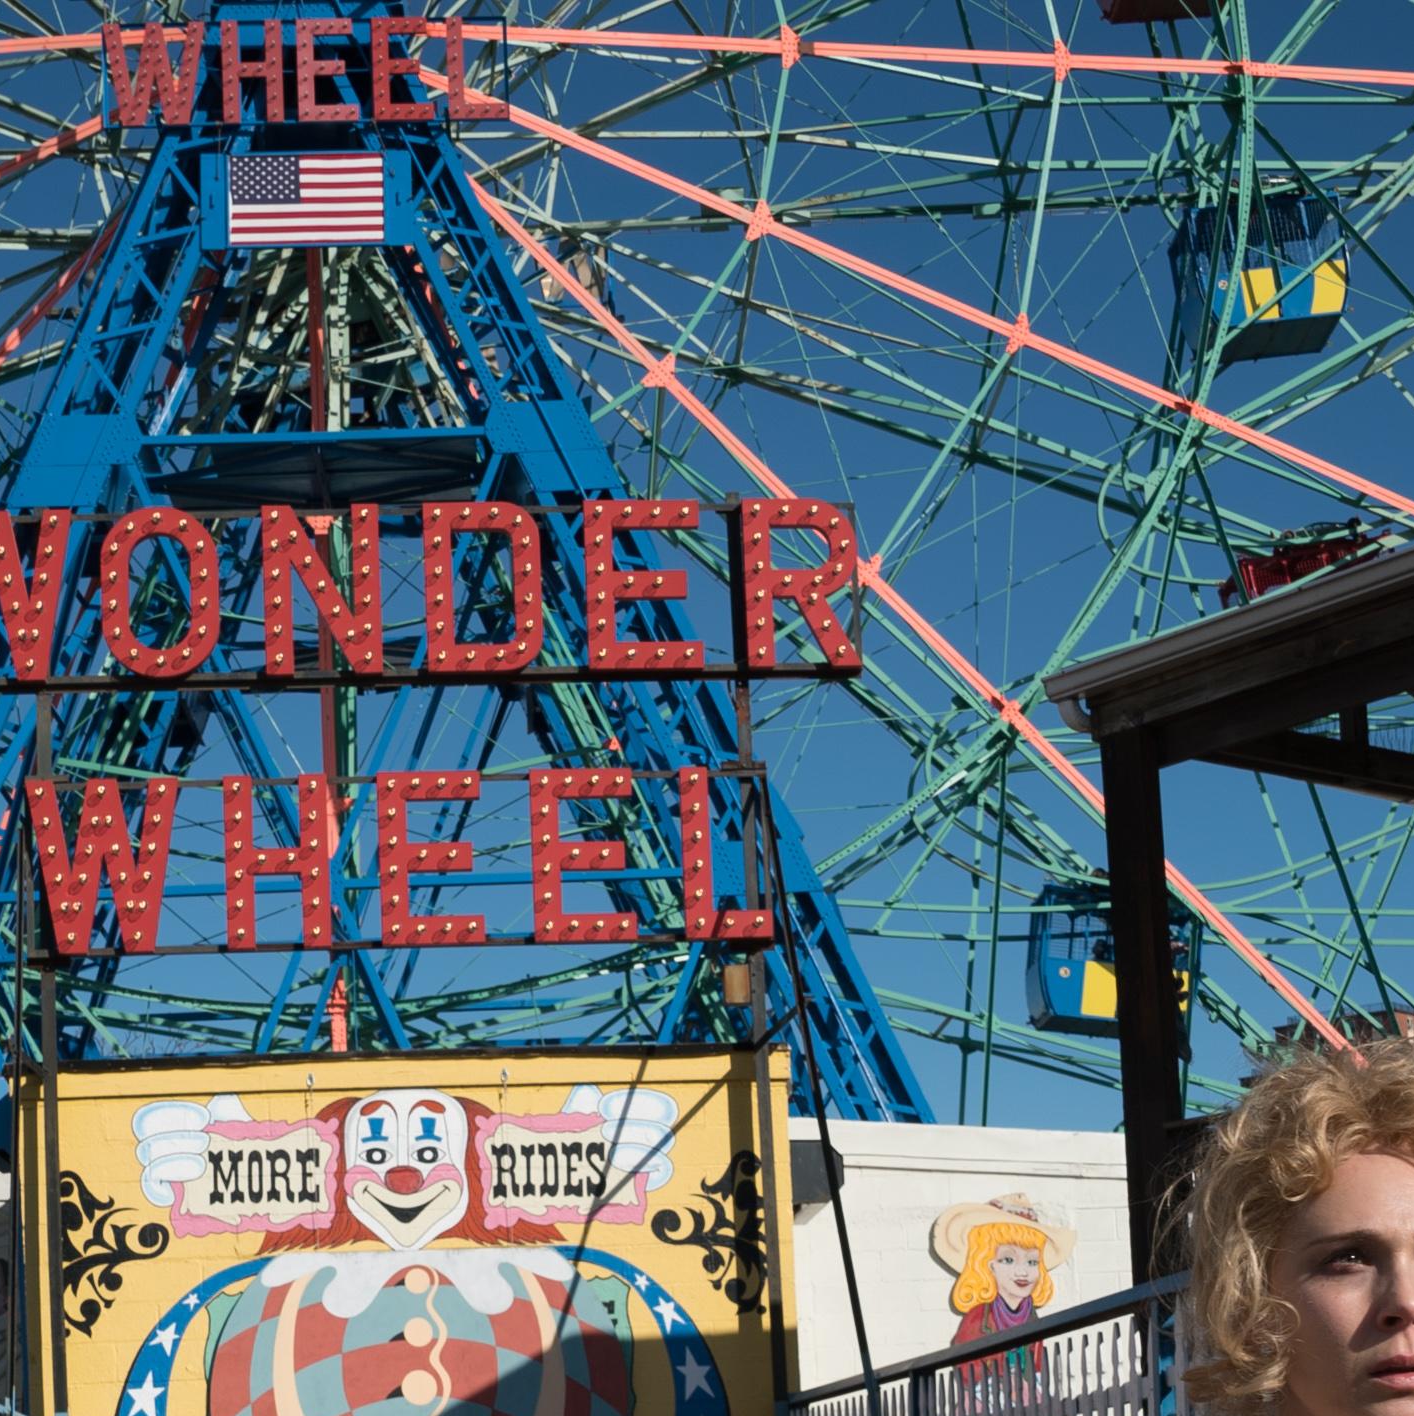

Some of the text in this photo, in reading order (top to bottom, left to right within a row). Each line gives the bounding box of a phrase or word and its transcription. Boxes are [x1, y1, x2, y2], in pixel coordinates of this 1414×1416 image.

[101, 17, 510, 128] WHEEL
[23, 765, 774, 956] WHEEL
[207, 1140, 607, 1205] MORE RIDES
